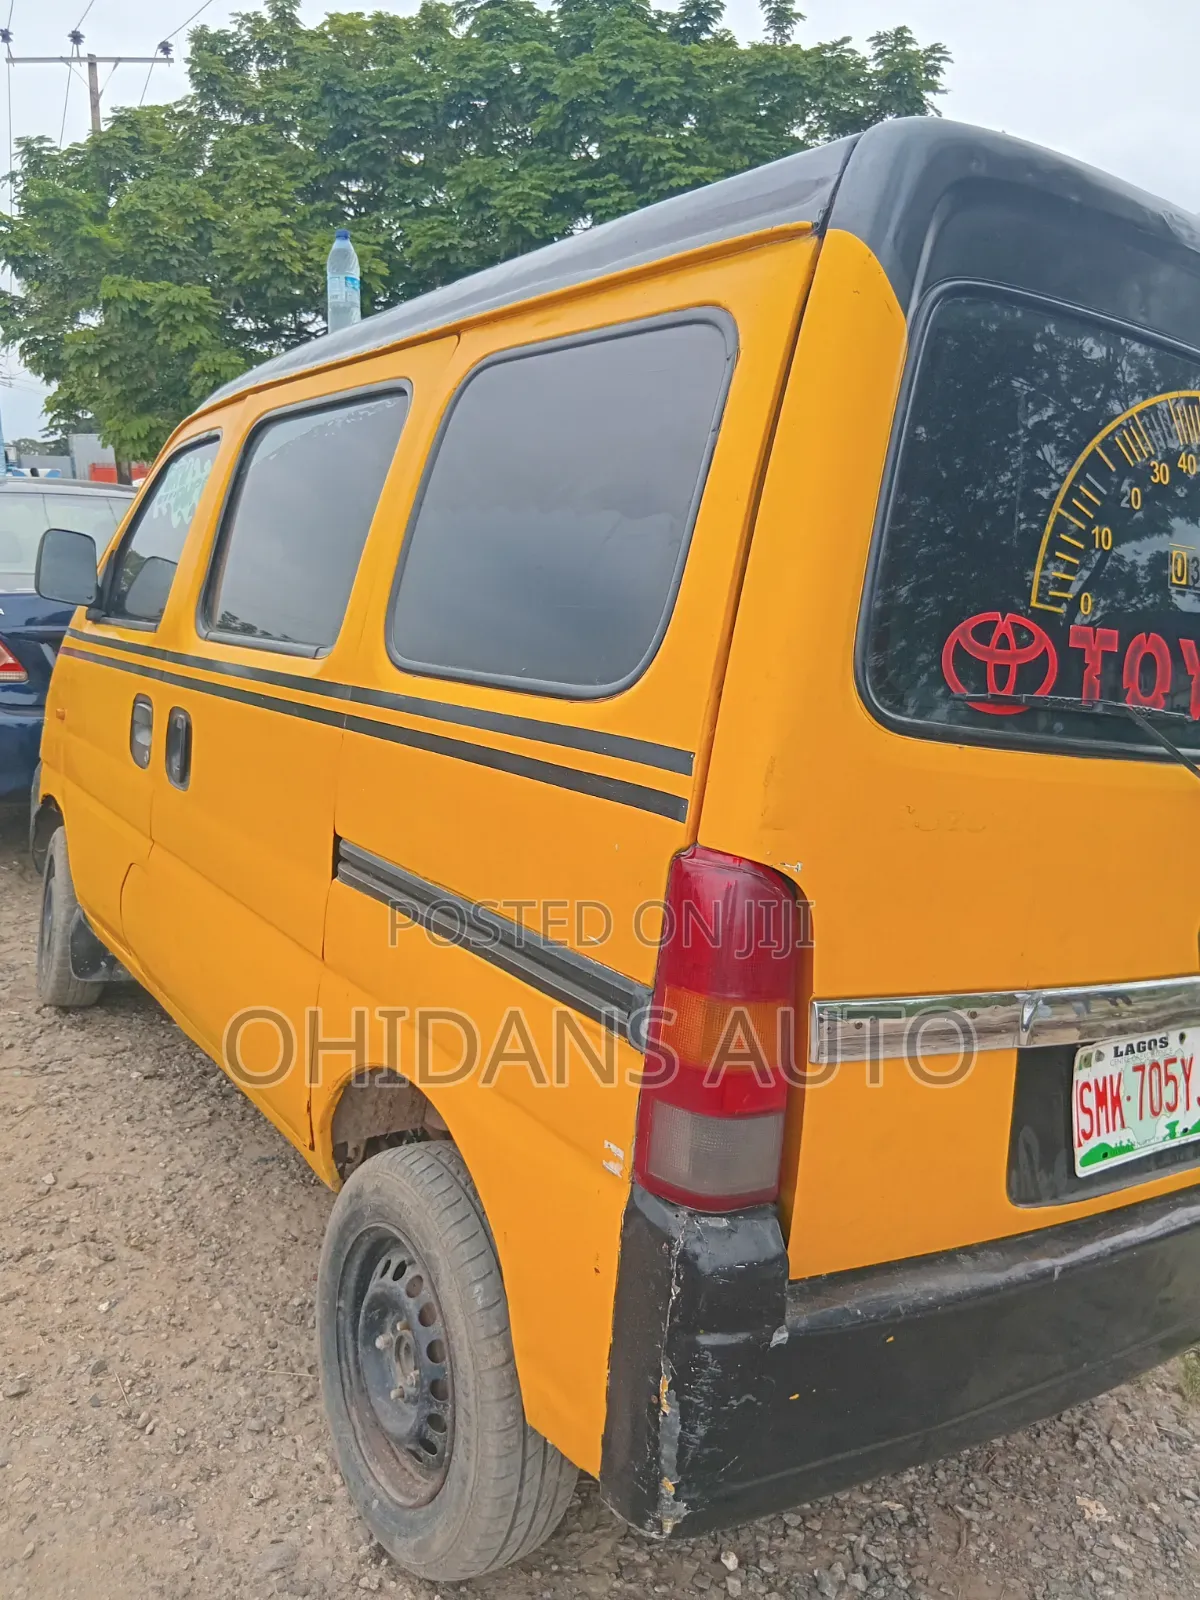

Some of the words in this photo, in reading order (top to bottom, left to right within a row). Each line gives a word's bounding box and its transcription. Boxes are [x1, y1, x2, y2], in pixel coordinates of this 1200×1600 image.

[1150, 460, 1170, 485] 30
[1177, 452, 1197, 475] 40
[1120, 487, 1141, 510] 20
[1091, 525, 1113, 551] 10
[1080, 592, 1092, 616] 0
[1113, 1036, 1169, 1058] LAGOS
